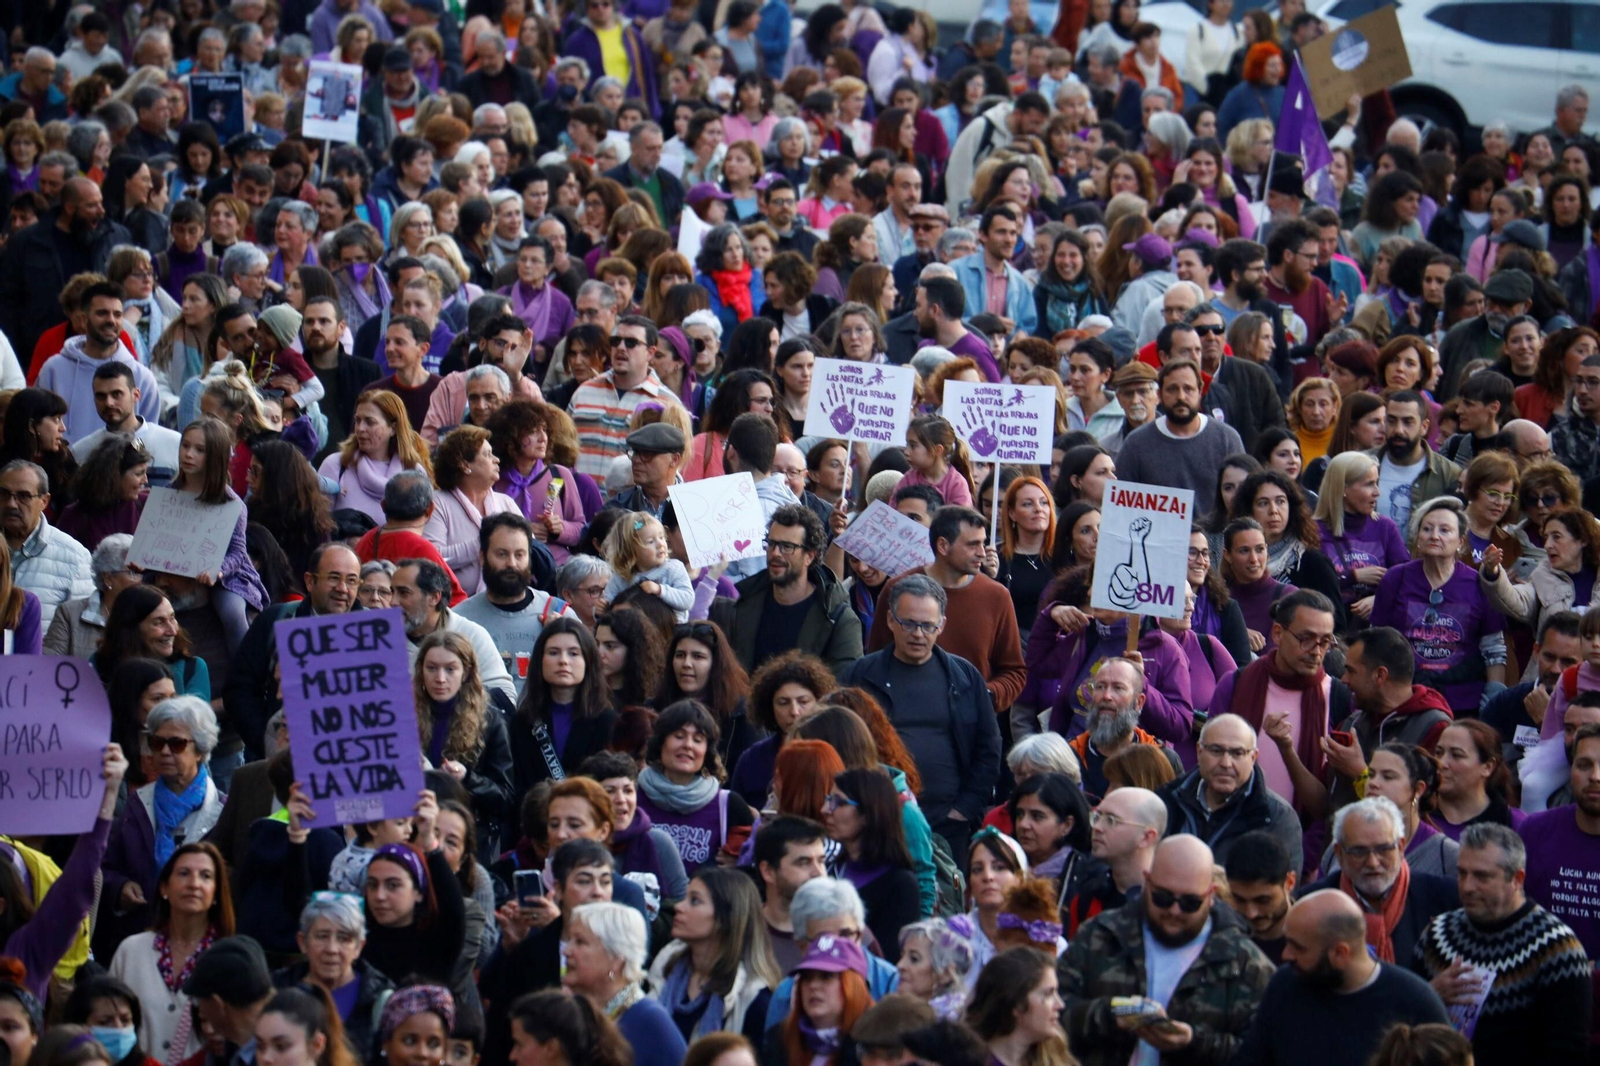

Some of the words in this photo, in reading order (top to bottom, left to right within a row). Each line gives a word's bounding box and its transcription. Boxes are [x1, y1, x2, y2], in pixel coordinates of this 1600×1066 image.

[839, 364, 863, 375] SOMOS
[826, 373, 840, 381] LAS
[840, 375, 864, 385] NIETAS
[846, 386, 853, 395] DE
[855, 388, 868, 397] LAS
[869, 390, 896, 401] BRUJAS
[974, 386, 1002, 396] SOMOS
[960, 396, 976, 404] LAS
[976, 397, 1003, 407] NIETAS
[857, 402, 878, 415] QUE
[879, 405, 894, 417] NO
[985, 409, 994, 418] DE
[995, 410, 1009, 418] LAS
[1010, 410, 1039, 420] BRUJAS
[853, 427, 892, 441] QUEMAR
[999, 423, 1021, 436] QUE
[1022, 425, 1037, 437] NO
[996, 448, 1036, 461] QUEMAR
[1110, 485, 1186, 520] ¡AVANZA!
[1136, 583, 1175, 606] 8M
[1421, 617, 1454, 627] SMOS
[288, 624, 339, 668] QUE
[343, 618, 393, 653] SER
[301, 663, 388, 700] MUJER
[0, 670, 33, 708] CÍ
[310, 705, 343, 736] NO
[348, 700, 396, 732] NOS
[4, 723, 63, 755] PARA
[313, 732, 399, 765] CUESTE
[27, 766, 93, 801] SERLO
[309, 769, 343, 800] LA
[345, 764, 406, 794] VIDA
[1559, 866, 1583, 879] LUCHA
[1564, 881, 1573, 890] TE
[1576, 883, 1598, 893] FALTE
[1552, 891, 1579, 904] PORQUE
[1568, 906, 1589, 917] FALTA
